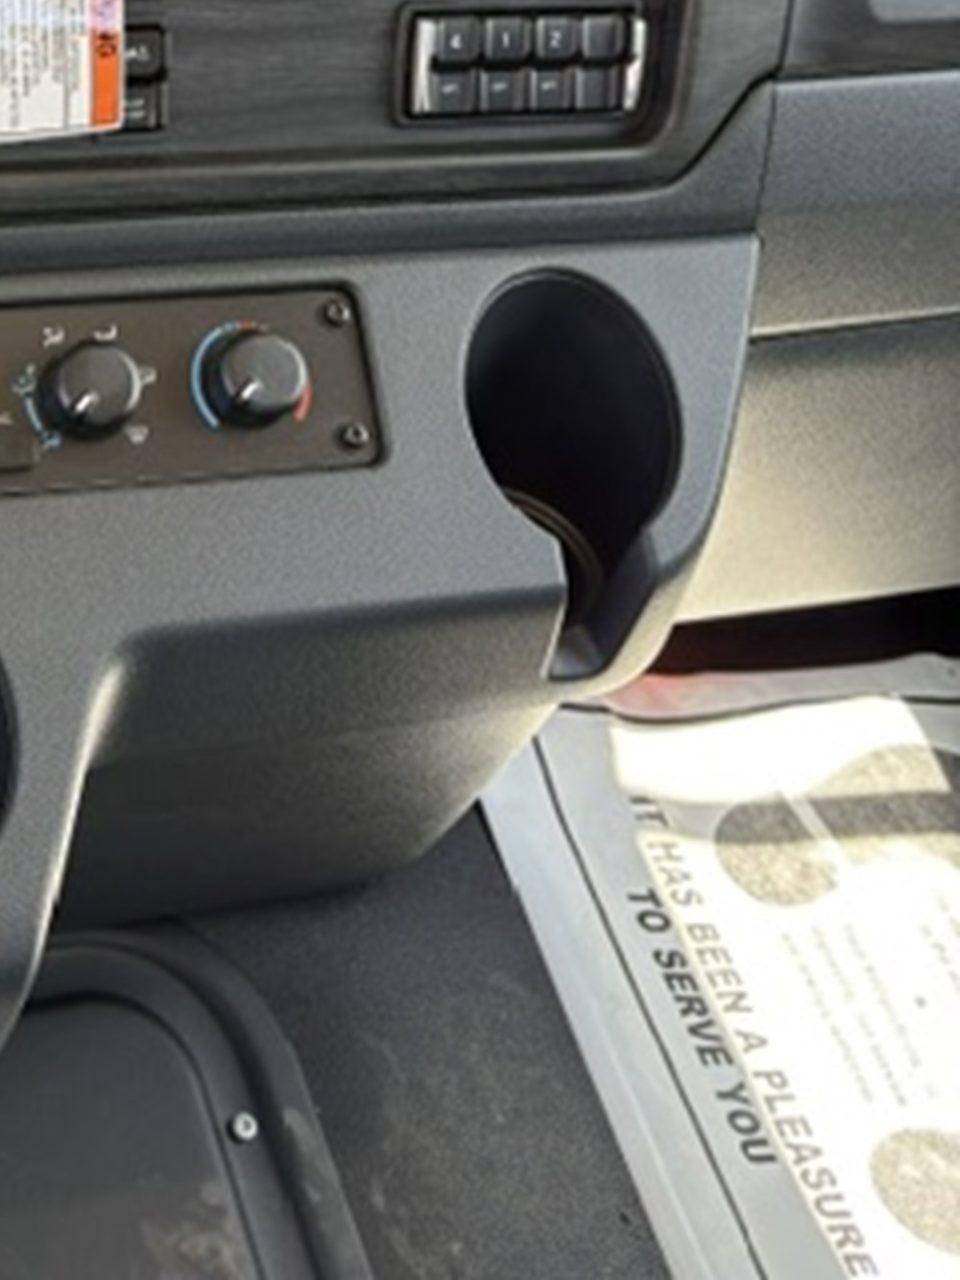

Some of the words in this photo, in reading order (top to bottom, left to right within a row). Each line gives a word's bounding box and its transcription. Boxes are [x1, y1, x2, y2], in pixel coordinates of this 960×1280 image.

[628, 794, 671, 828] IT
[645, 840, 704, 908] HAS
[685, 922, 754, 1014] BEEN
[626, 886, 672, 934] TO
[653, 948, 734, 1068] SERVE
[715, 1081, 778, 1165] YOU
[734, 1028, 769, 1054] A
[752, 1068, 881, 1277] PLEASURE
